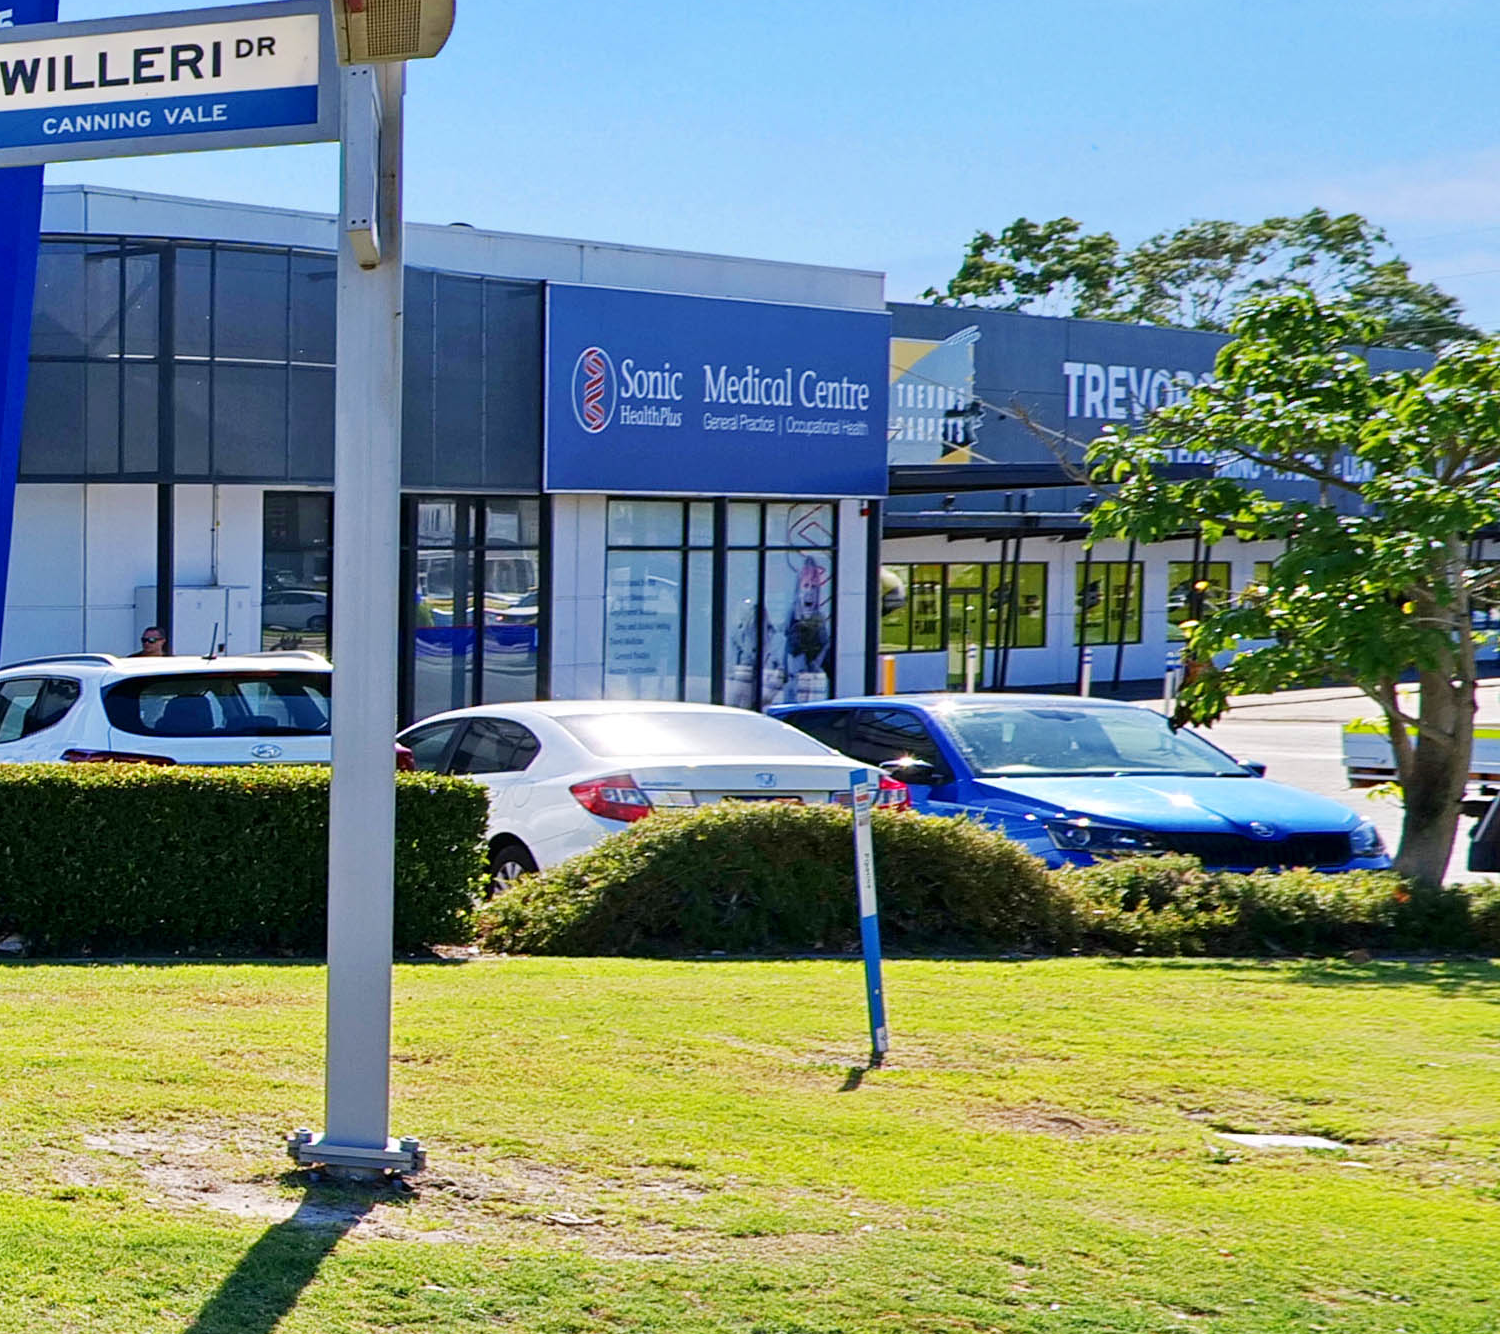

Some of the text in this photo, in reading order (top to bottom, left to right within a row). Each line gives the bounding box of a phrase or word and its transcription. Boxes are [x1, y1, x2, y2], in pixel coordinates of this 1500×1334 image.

[0, 36, 276, 96] WILLERI DR
[42, 104, 228, 135] CANNING VALE
[620, 358, 683, 400] Sonic
[703, 365, 870, 411] Medical Centre
[620, 405, 682, 427] HealthPlus
[703, 412, 738, 430] General
[739, 414, 775, 432] Practice
[786, 416, 840, 436] Occupational
